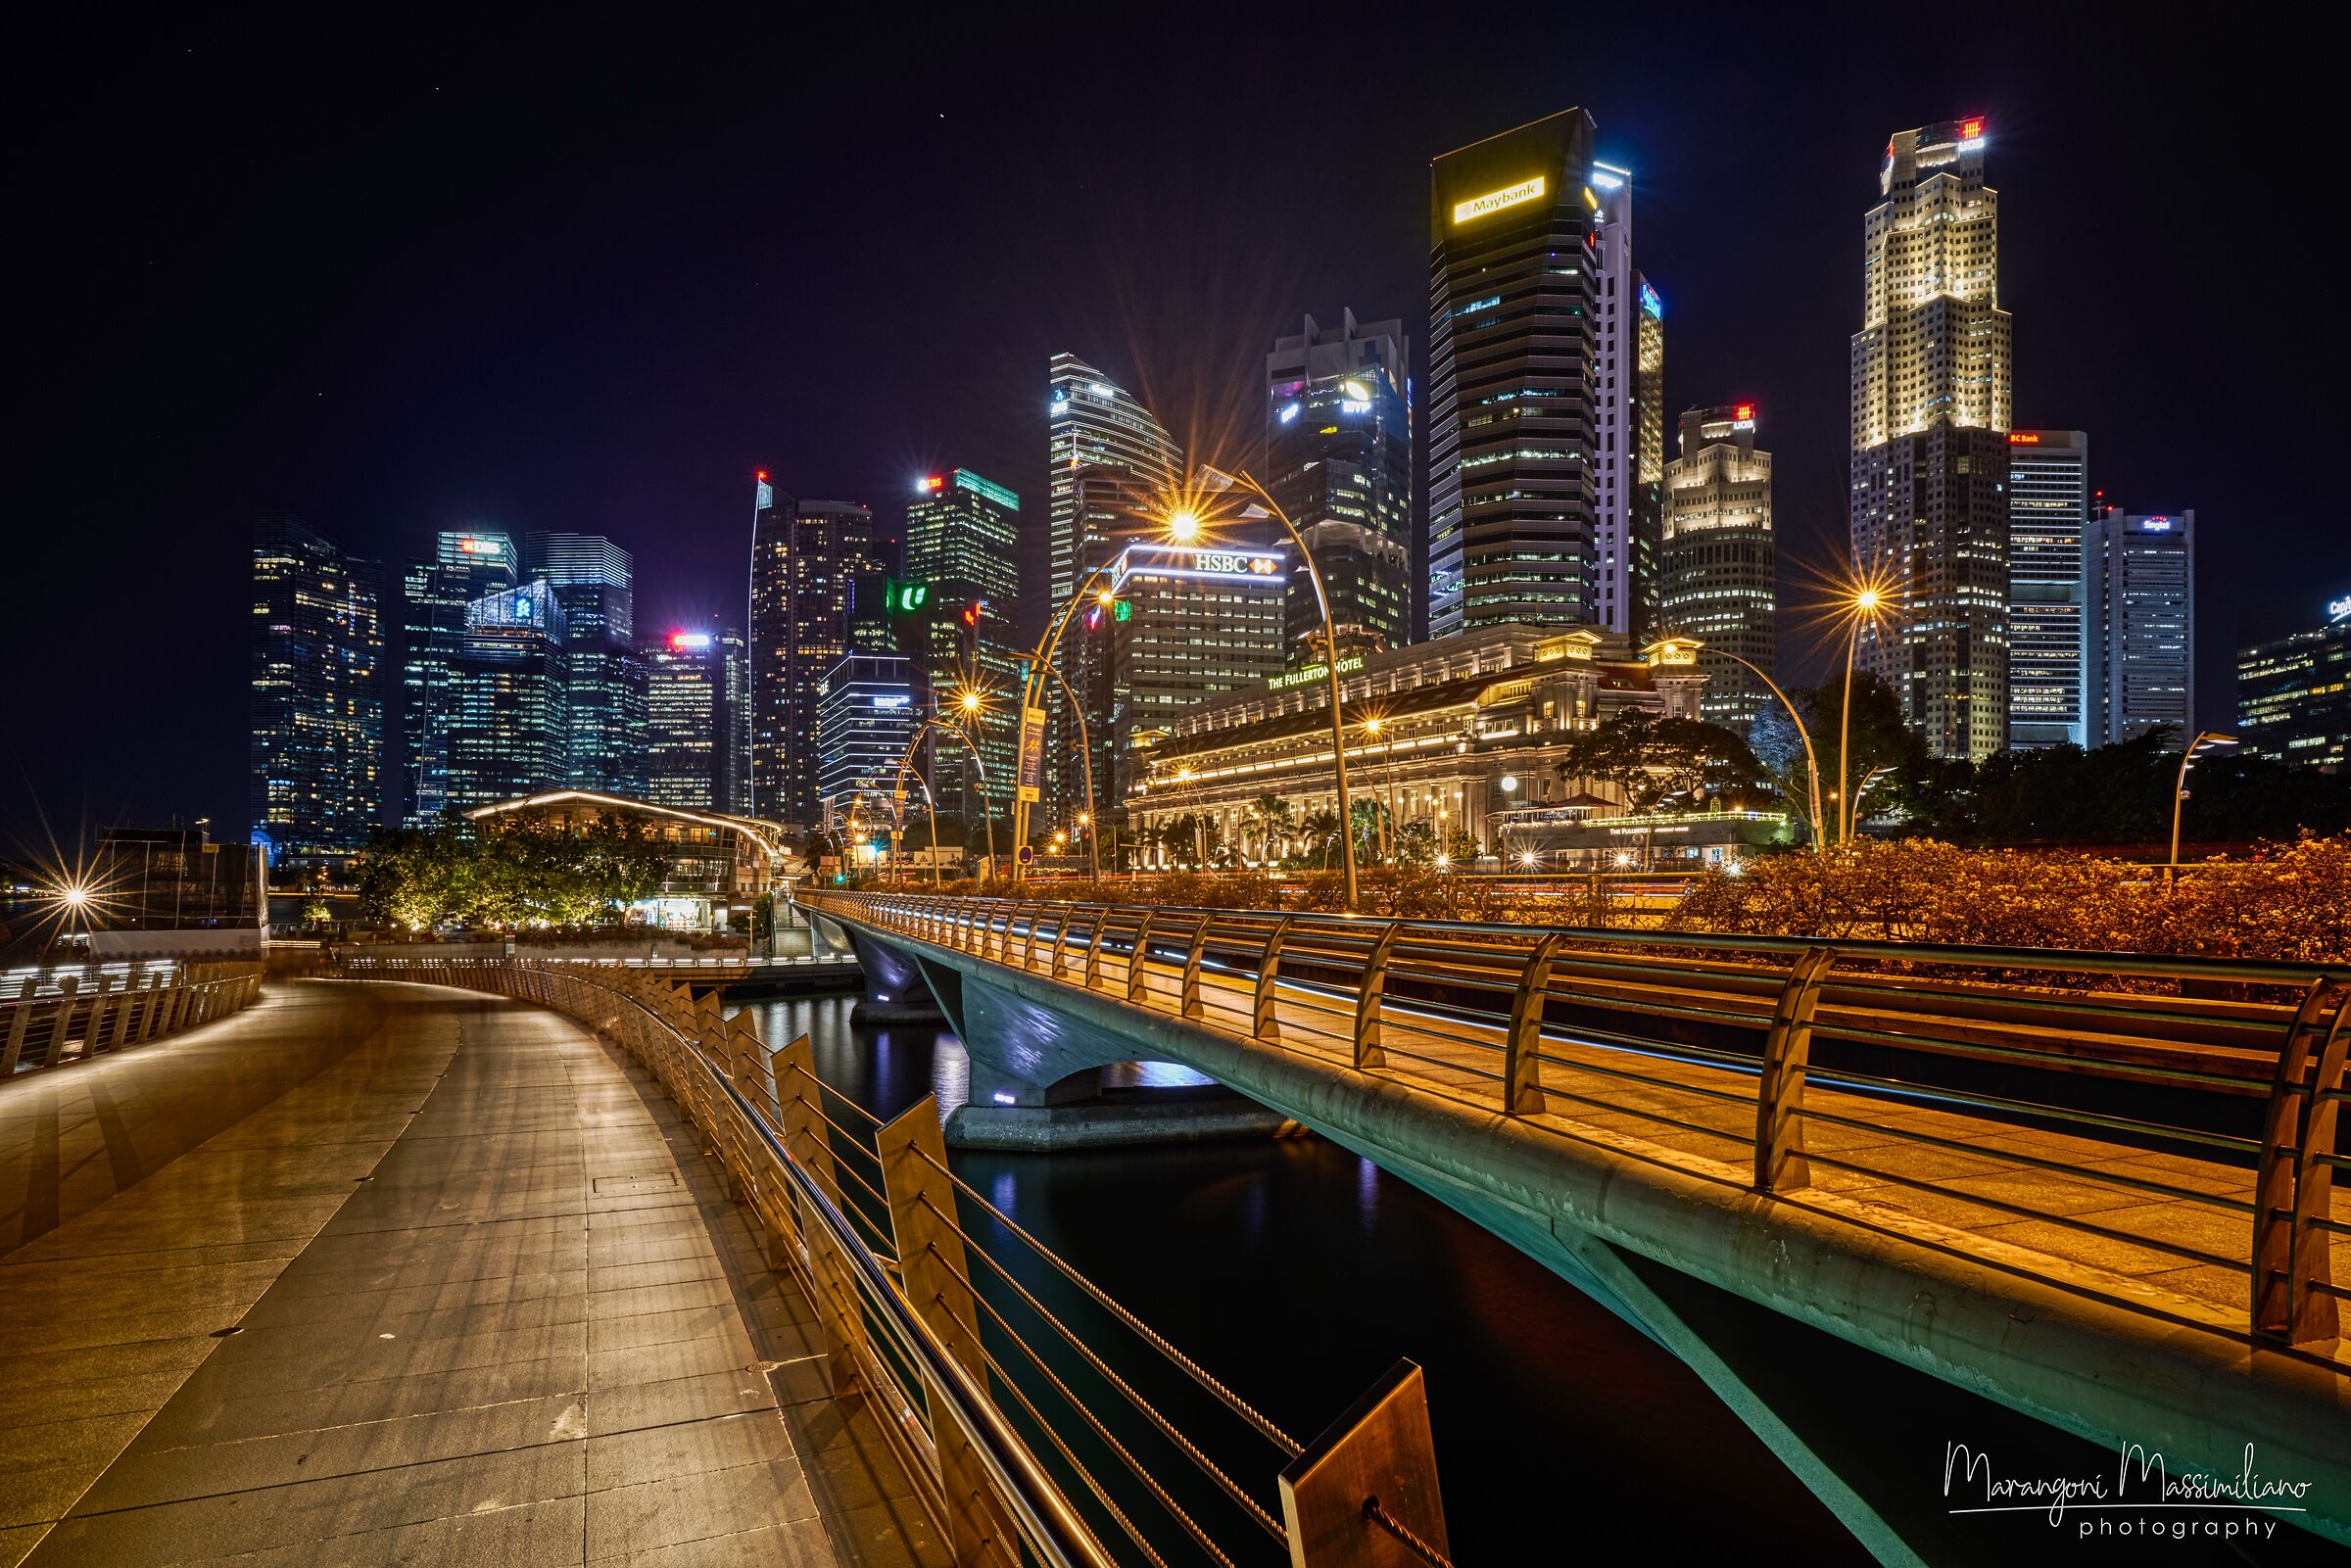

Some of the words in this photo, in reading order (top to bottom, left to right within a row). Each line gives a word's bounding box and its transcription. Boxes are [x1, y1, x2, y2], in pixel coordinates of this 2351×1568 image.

[1473, 184, 1536, 212] Maybank
[1733, 419, 1753, 430] UOB
[2021, 434, 2039, 443] Bank
[2143, 520, 2170, 531] Singtel
[474, 541, 502, 554] DBS
[1195, 553, 1247, 574] HSBC
[1268, 677, 1284, 690] THE
[1284, 665, 1330, 687] FULLERTON
[1333, 657, 1364, 674] HOTEL
